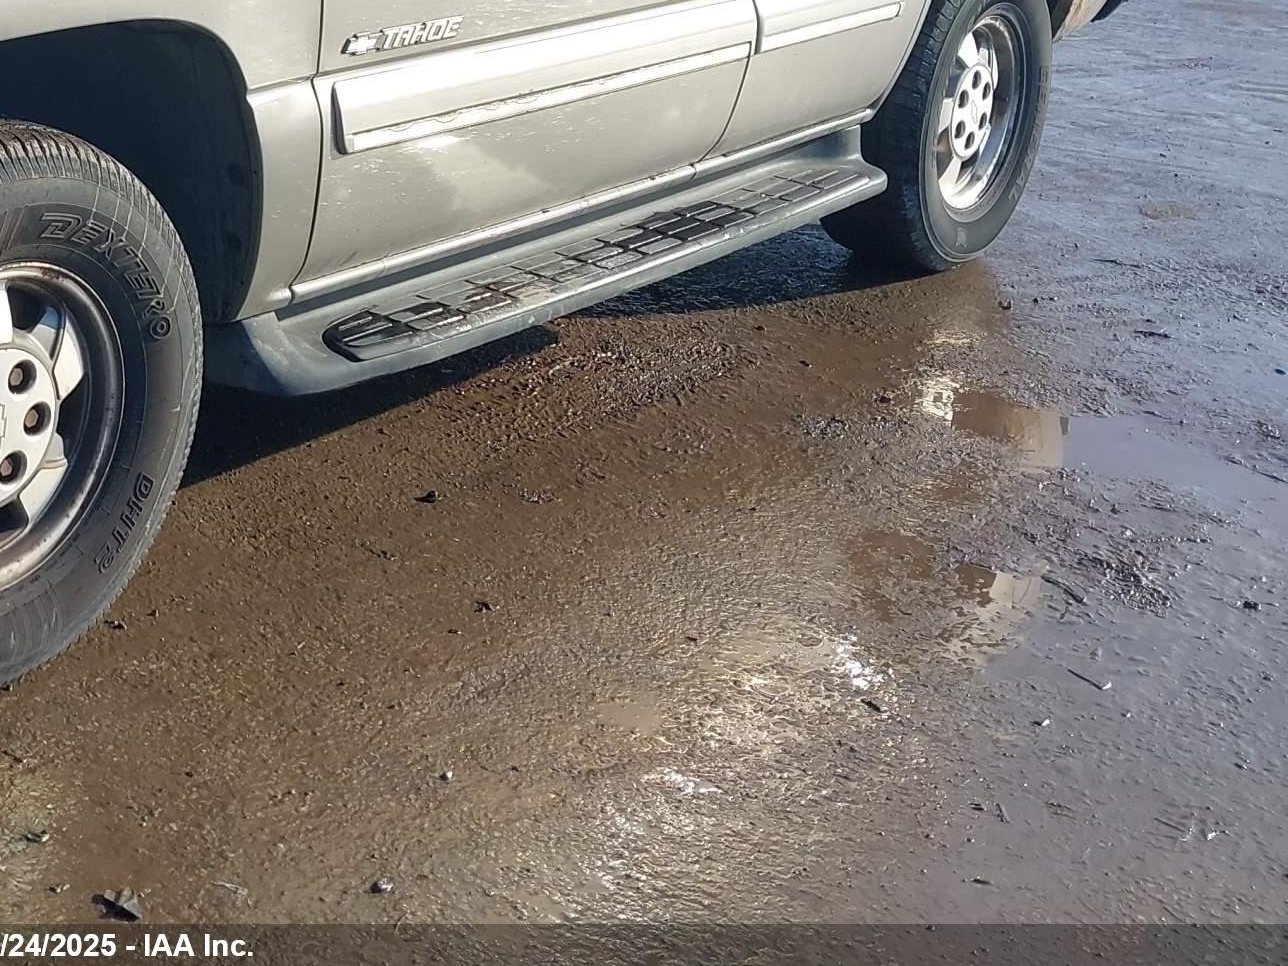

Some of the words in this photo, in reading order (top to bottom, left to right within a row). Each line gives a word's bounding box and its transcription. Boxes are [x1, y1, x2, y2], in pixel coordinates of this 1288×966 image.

[382, 16, 464, 50] TAHOE
[40, 212, 172, 339] DEXTERO
[94, 471, 156, 574] DHT2
